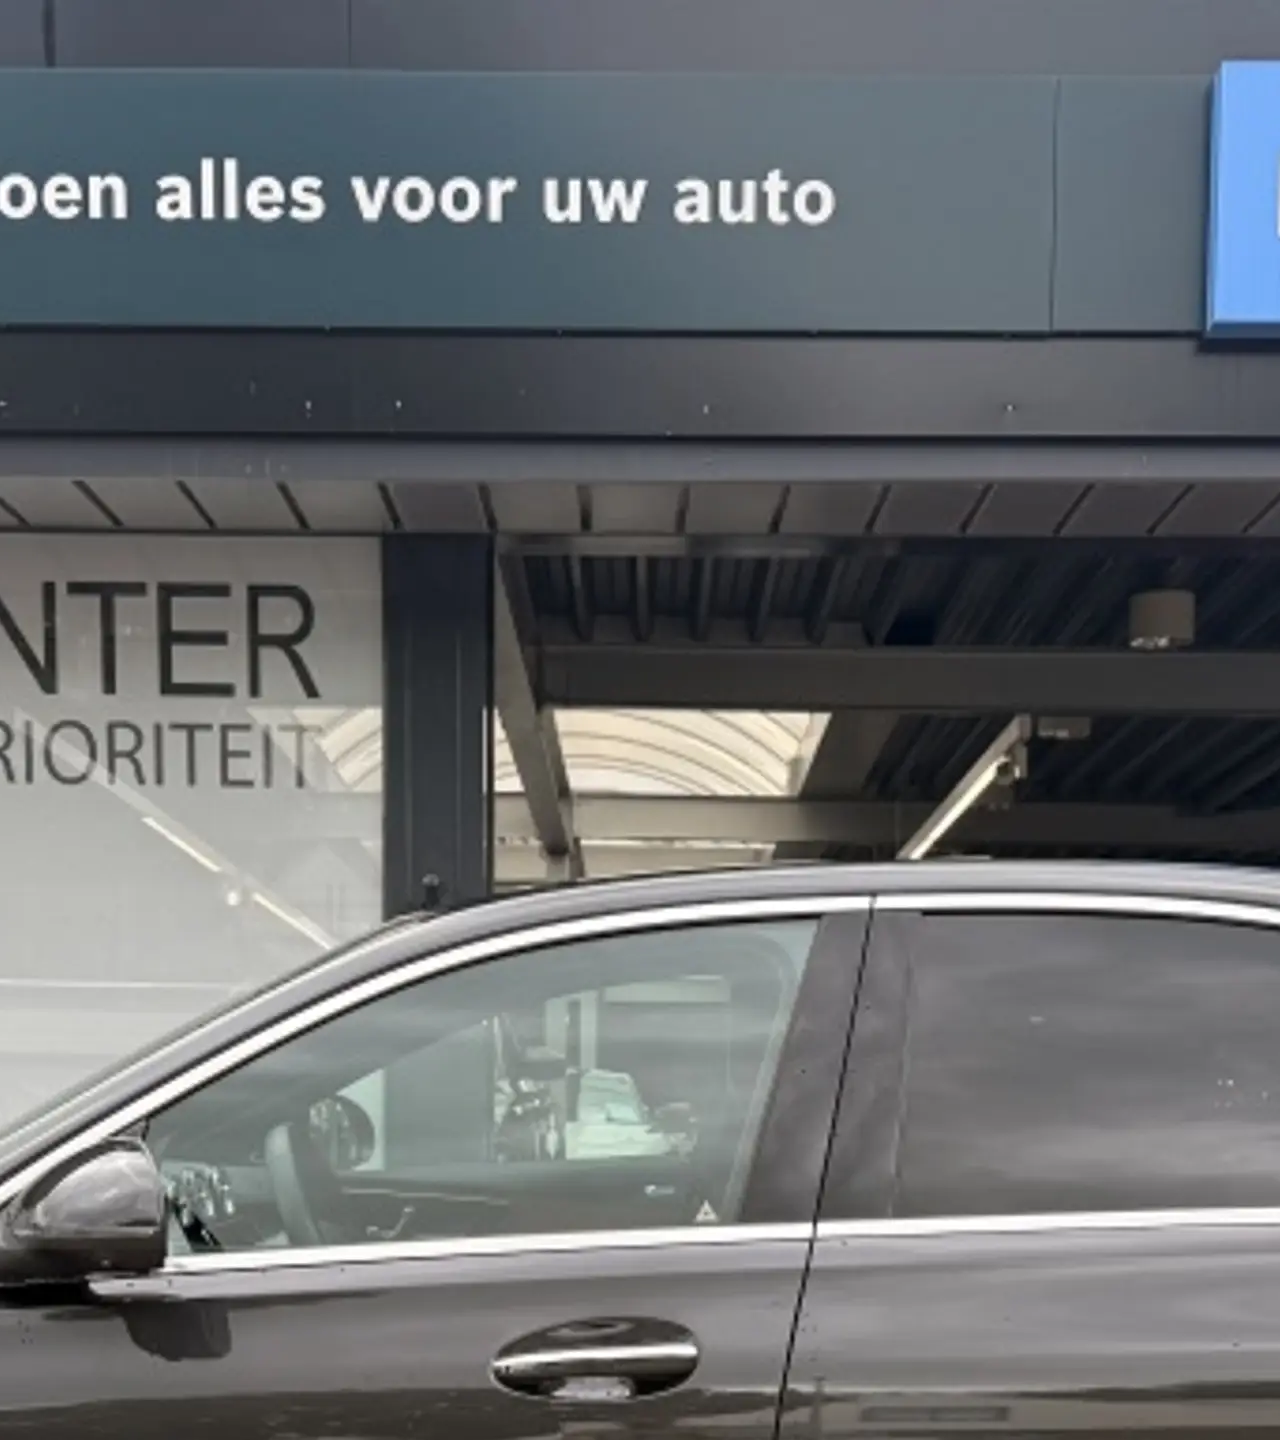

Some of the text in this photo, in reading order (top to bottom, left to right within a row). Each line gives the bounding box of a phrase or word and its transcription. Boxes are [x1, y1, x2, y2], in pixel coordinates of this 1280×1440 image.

[155, 156, 326, 222] alles
[351, 174, 517, 223] voor
[542, 176, 648, 224] uw
[673, 168, 837, 226] auto
